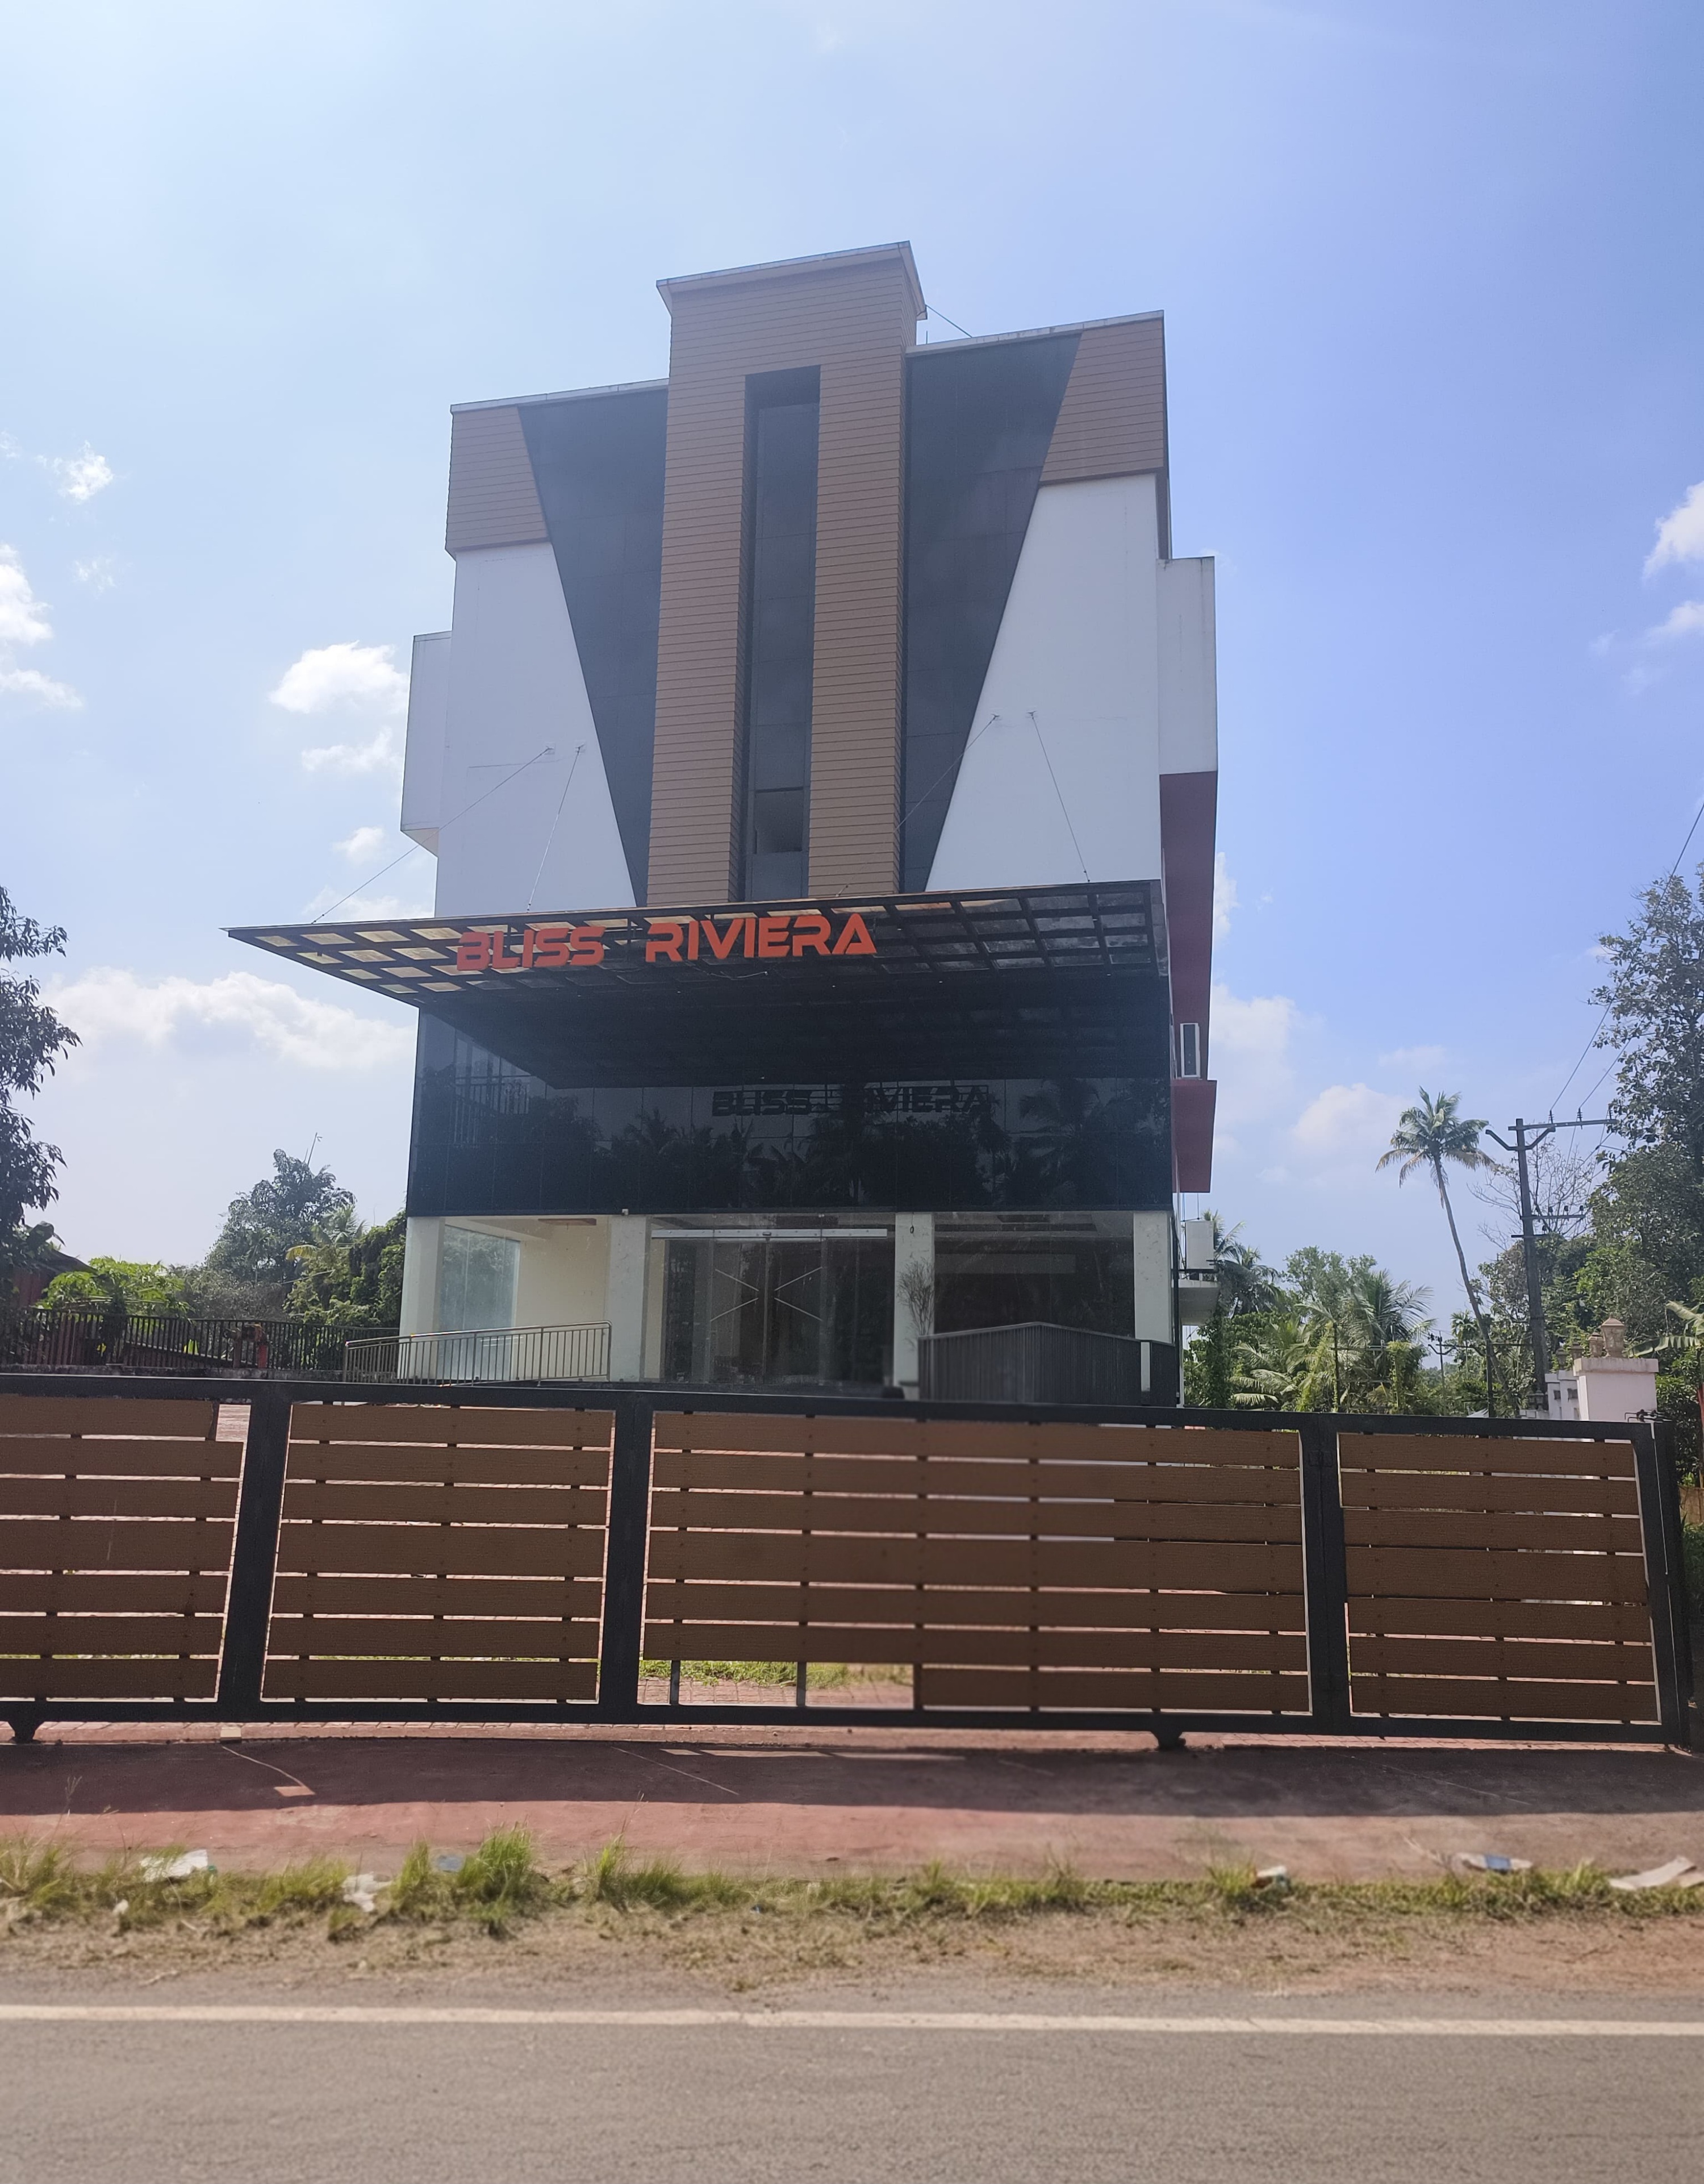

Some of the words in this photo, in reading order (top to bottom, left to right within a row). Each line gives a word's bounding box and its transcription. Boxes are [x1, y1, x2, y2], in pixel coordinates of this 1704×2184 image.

[457, 926, 605, 971] BLISS
[646, 913, 877, 962] RIVIERA
[712, 1089, 812, 1116] BLISS
[843, 1085, 991, 1115] IVIERA
